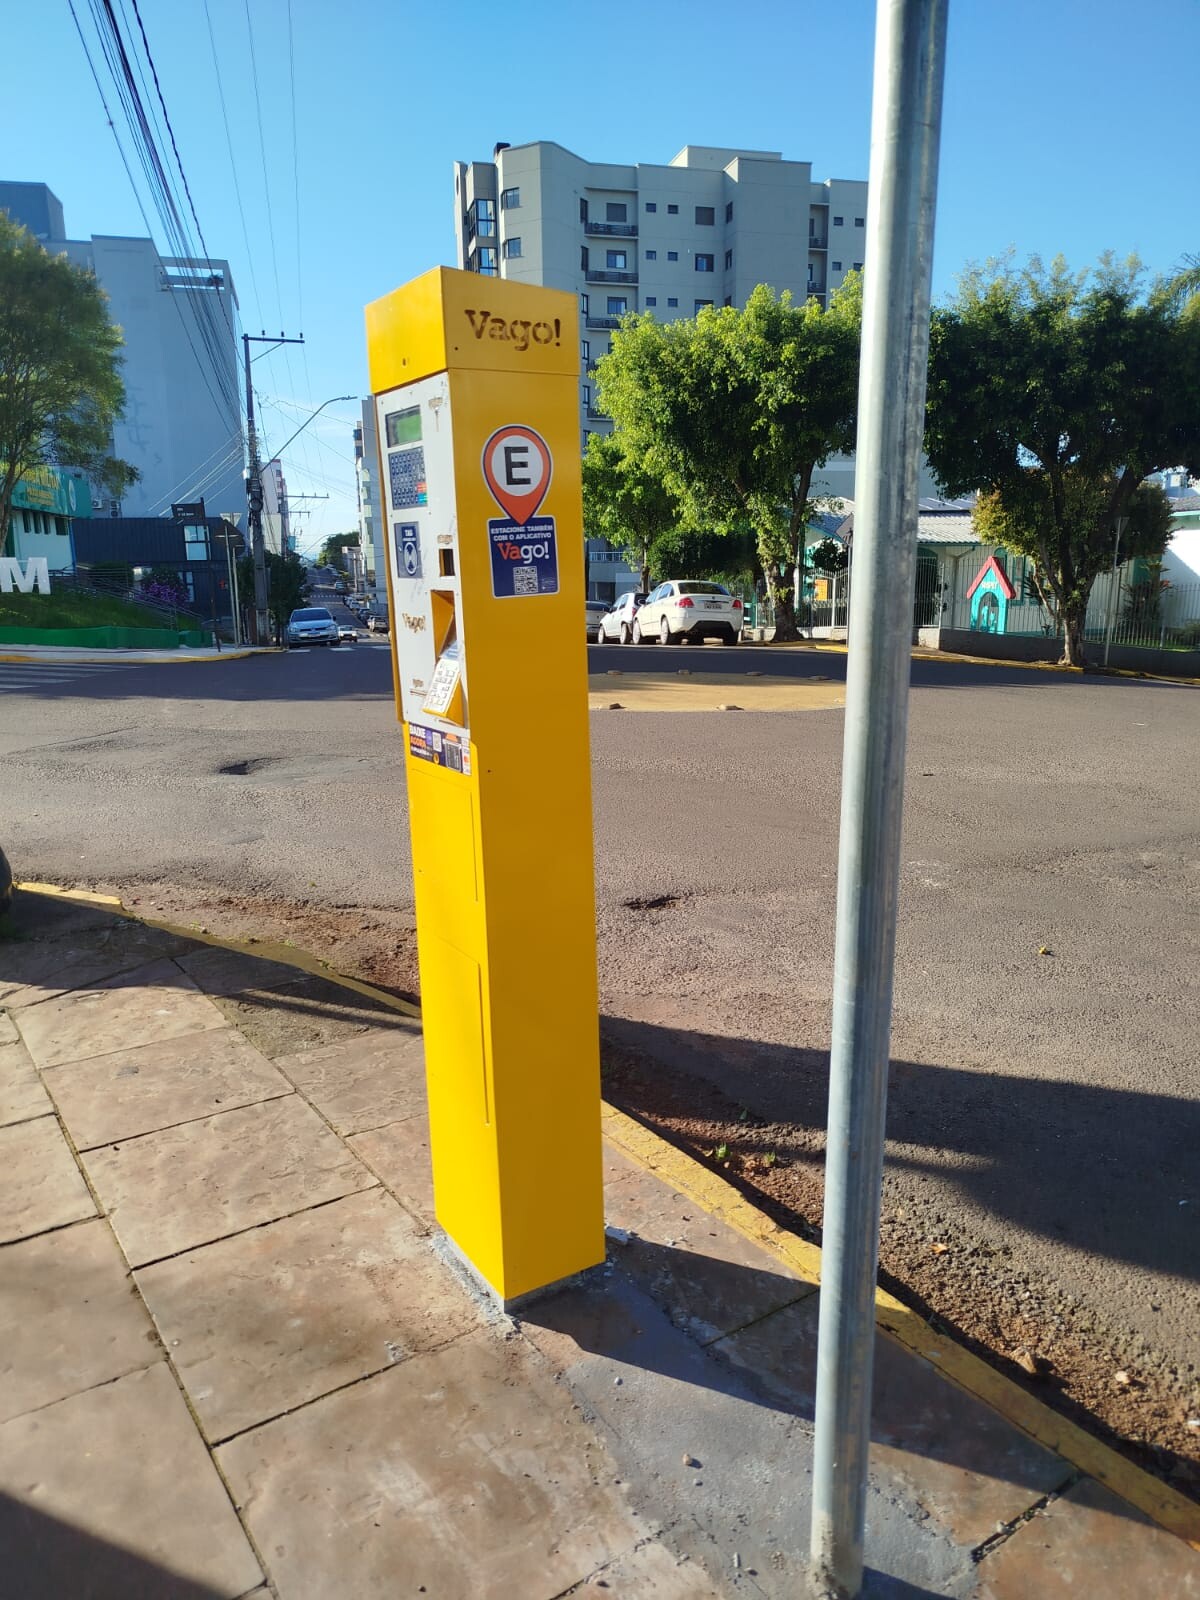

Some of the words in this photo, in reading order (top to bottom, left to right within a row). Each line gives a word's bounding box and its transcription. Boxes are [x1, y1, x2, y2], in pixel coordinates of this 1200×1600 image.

[464, 309, 561, 352] Vago!
[504, 446, 531, 486] E
[490, 526, 526, 535] ESTACIONE
[526, 524, 553, 533] TAMBÉM
[493, 534, 509, 542] COM
[515, 532, 552, 541] APLICATIVO
[497, 541, 549, 564] Vago!
[0, 556, 51, 595] M
